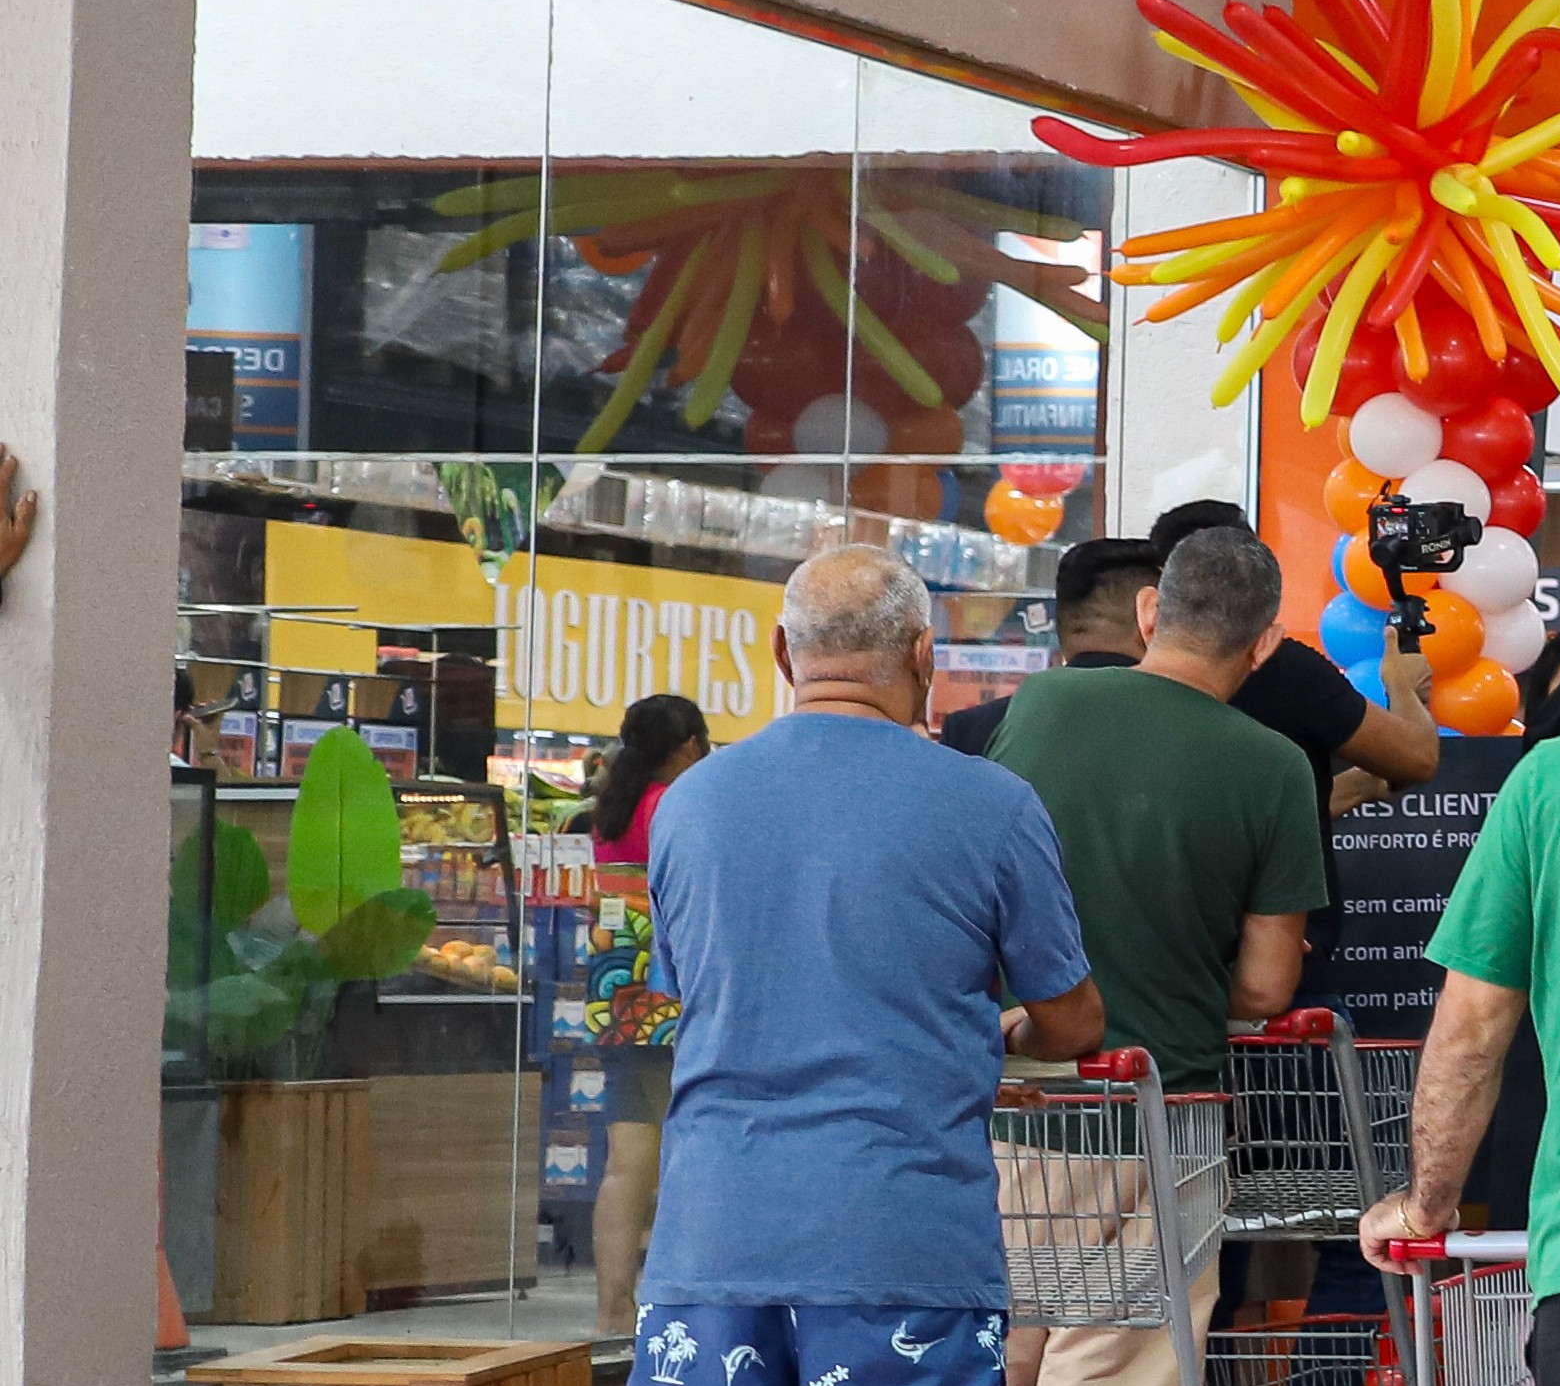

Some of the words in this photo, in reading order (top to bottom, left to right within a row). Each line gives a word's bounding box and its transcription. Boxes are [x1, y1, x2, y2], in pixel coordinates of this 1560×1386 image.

[495, 581, 756, 717] IOGURTES
[1332, 833, 1428, 850] CONFORTO
[1432, 829, 1443, 848] É
